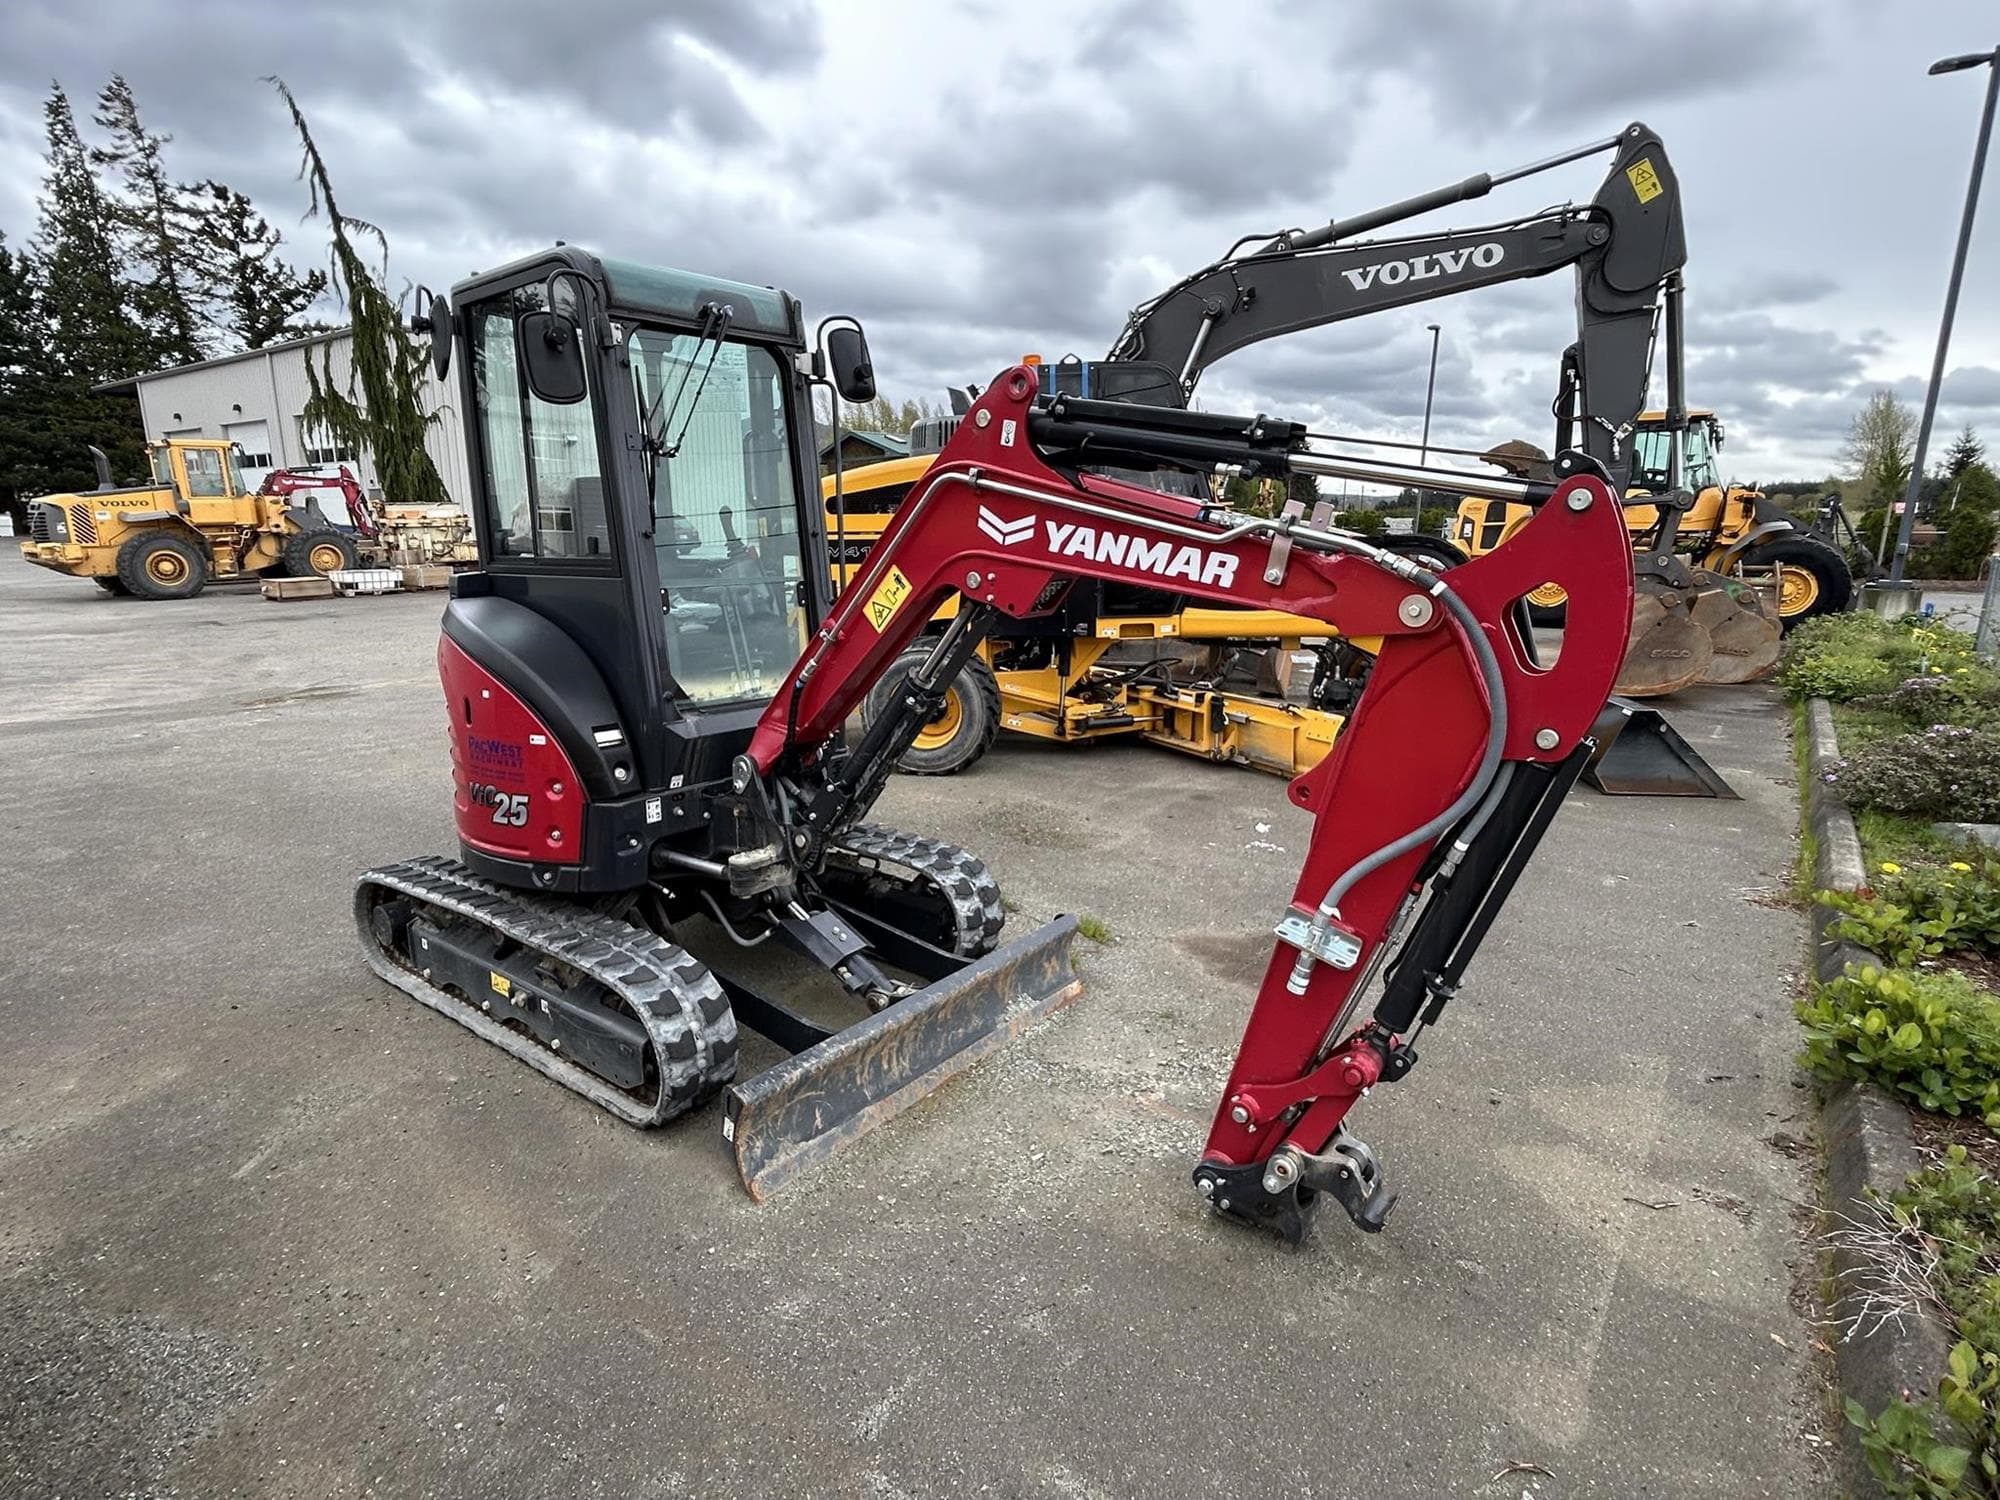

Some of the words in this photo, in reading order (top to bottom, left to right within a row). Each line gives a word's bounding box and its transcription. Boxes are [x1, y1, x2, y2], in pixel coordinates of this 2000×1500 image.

[1341, 243, 1505, 291] VOLVO
[99, 500, 150, 508] VOLVO
[1045, 520, 1240, 588] YANMAR
